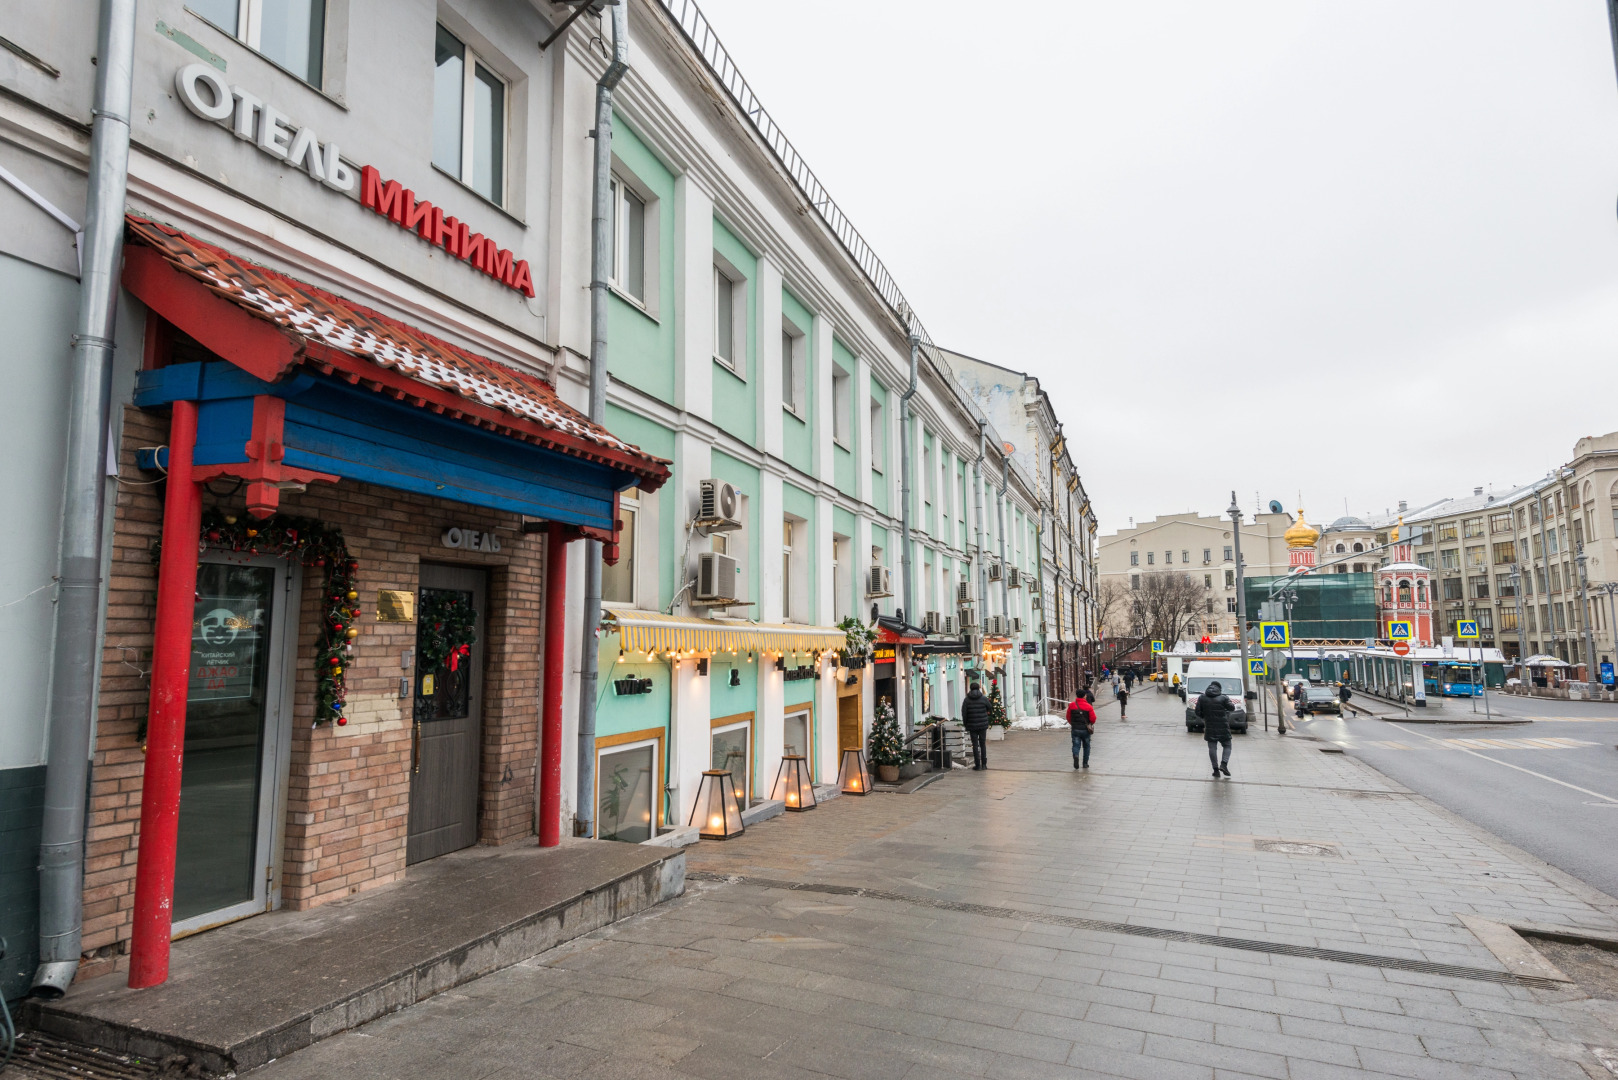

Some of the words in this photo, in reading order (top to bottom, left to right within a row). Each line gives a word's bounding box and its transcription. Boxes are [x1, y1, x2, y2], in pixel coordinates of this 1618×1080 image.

[175, 63, 354, 192] ОТЕЛЬ
[361, 164, 535, 298] МИНИМА
[442, 527, 502, 552] ОТЕЛЬ
[197, 666, 238, 678] ДЖАО
[207, 678, 225, 690] ДА
